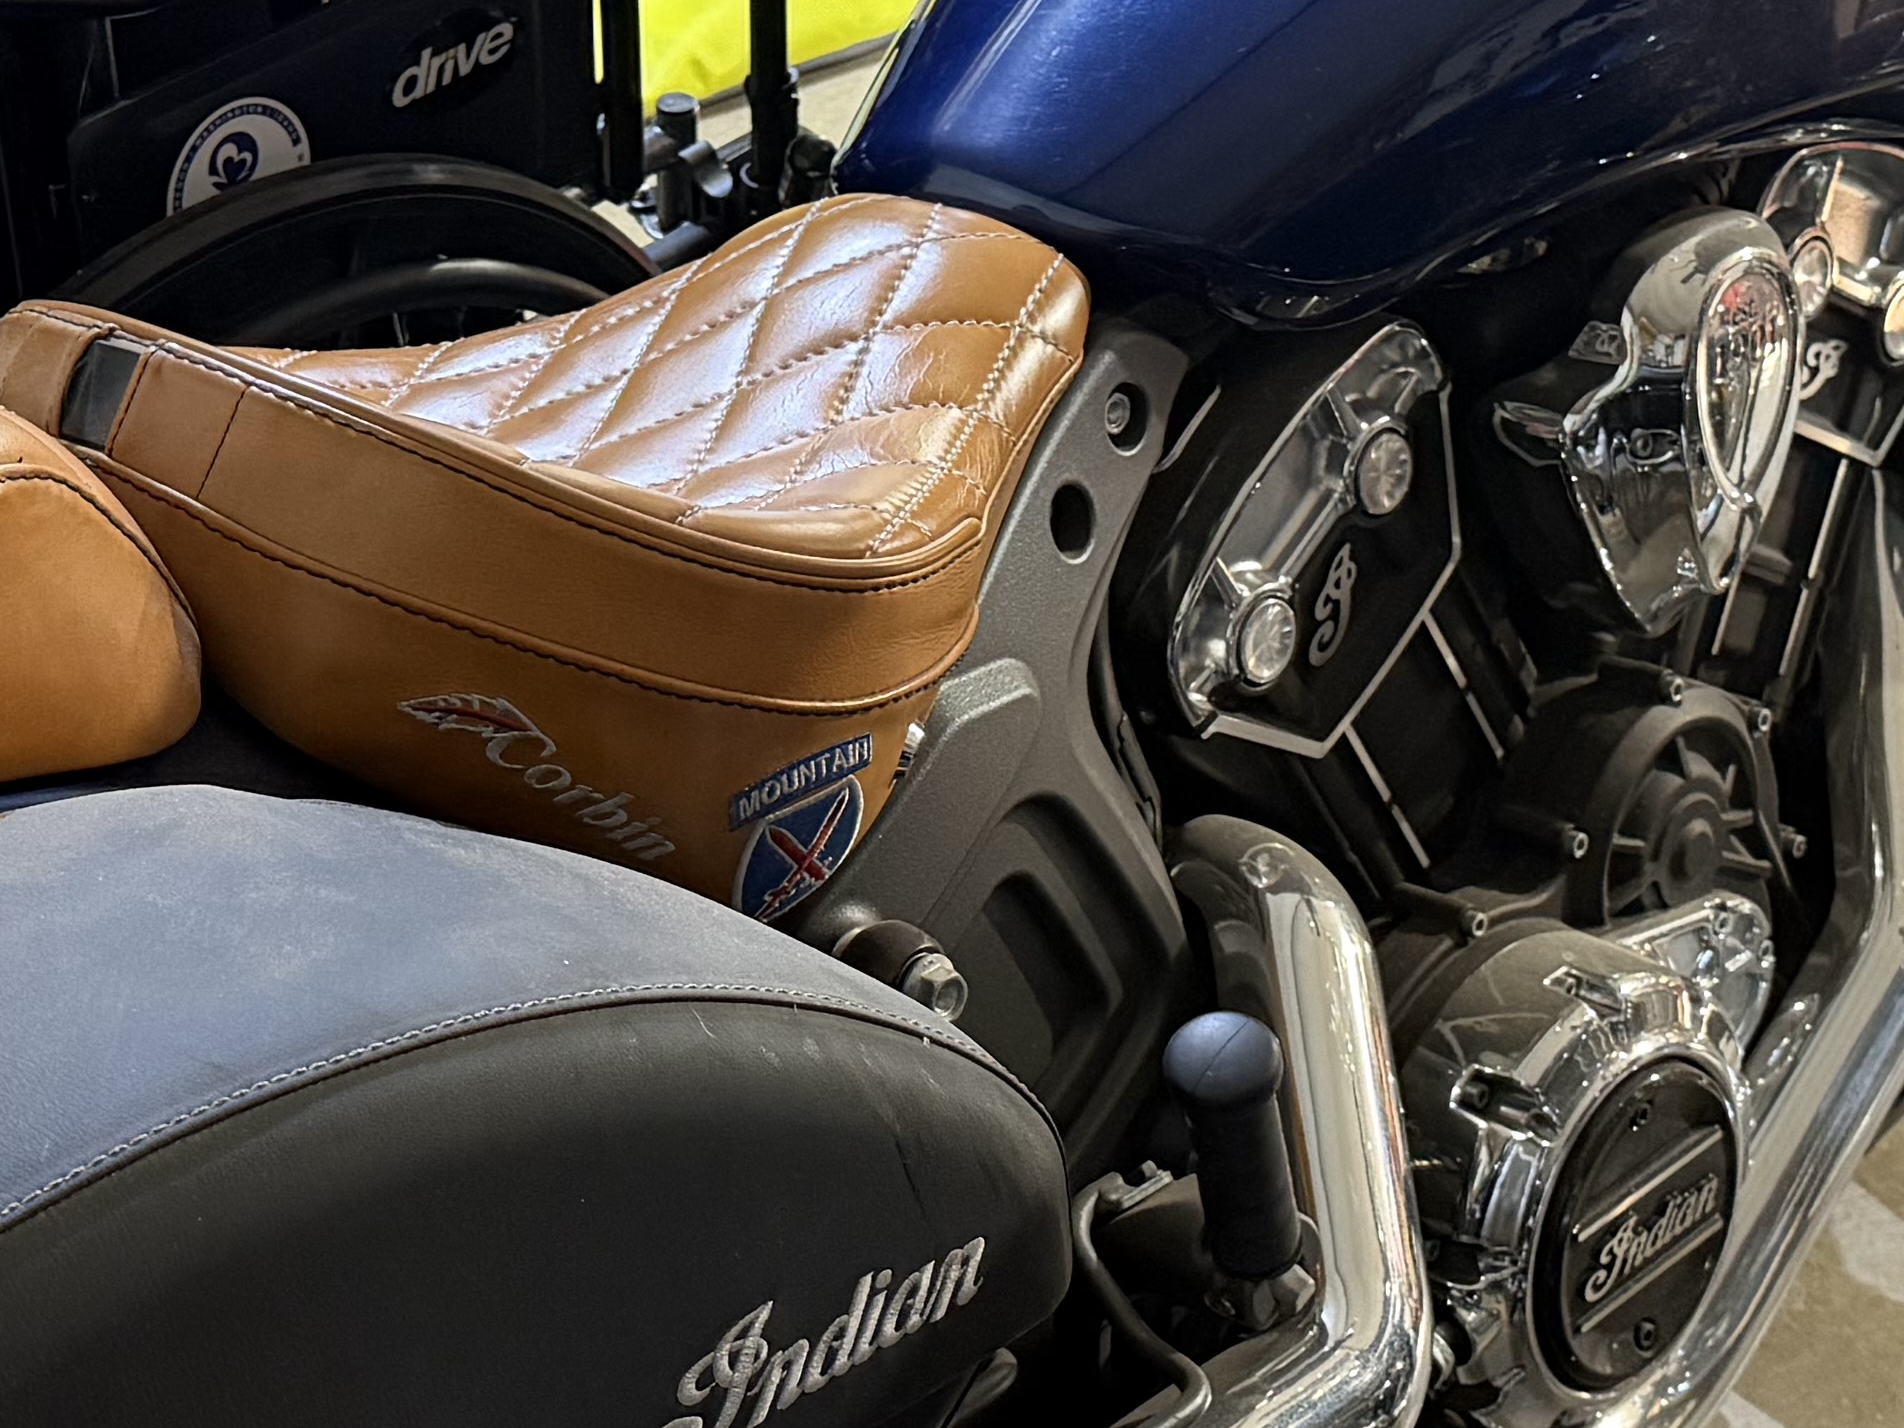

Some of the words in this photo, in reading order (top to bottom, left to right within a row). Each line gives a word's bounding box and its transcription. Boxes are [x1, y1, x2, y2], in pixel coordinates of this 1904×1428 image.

[392, 21, 515, 108] drive
[485, 727, 676, 861] Corbin
[736, 737, 871, 824] MOUNTAIN
[1584, 1173, 1721, 1303] Indian
